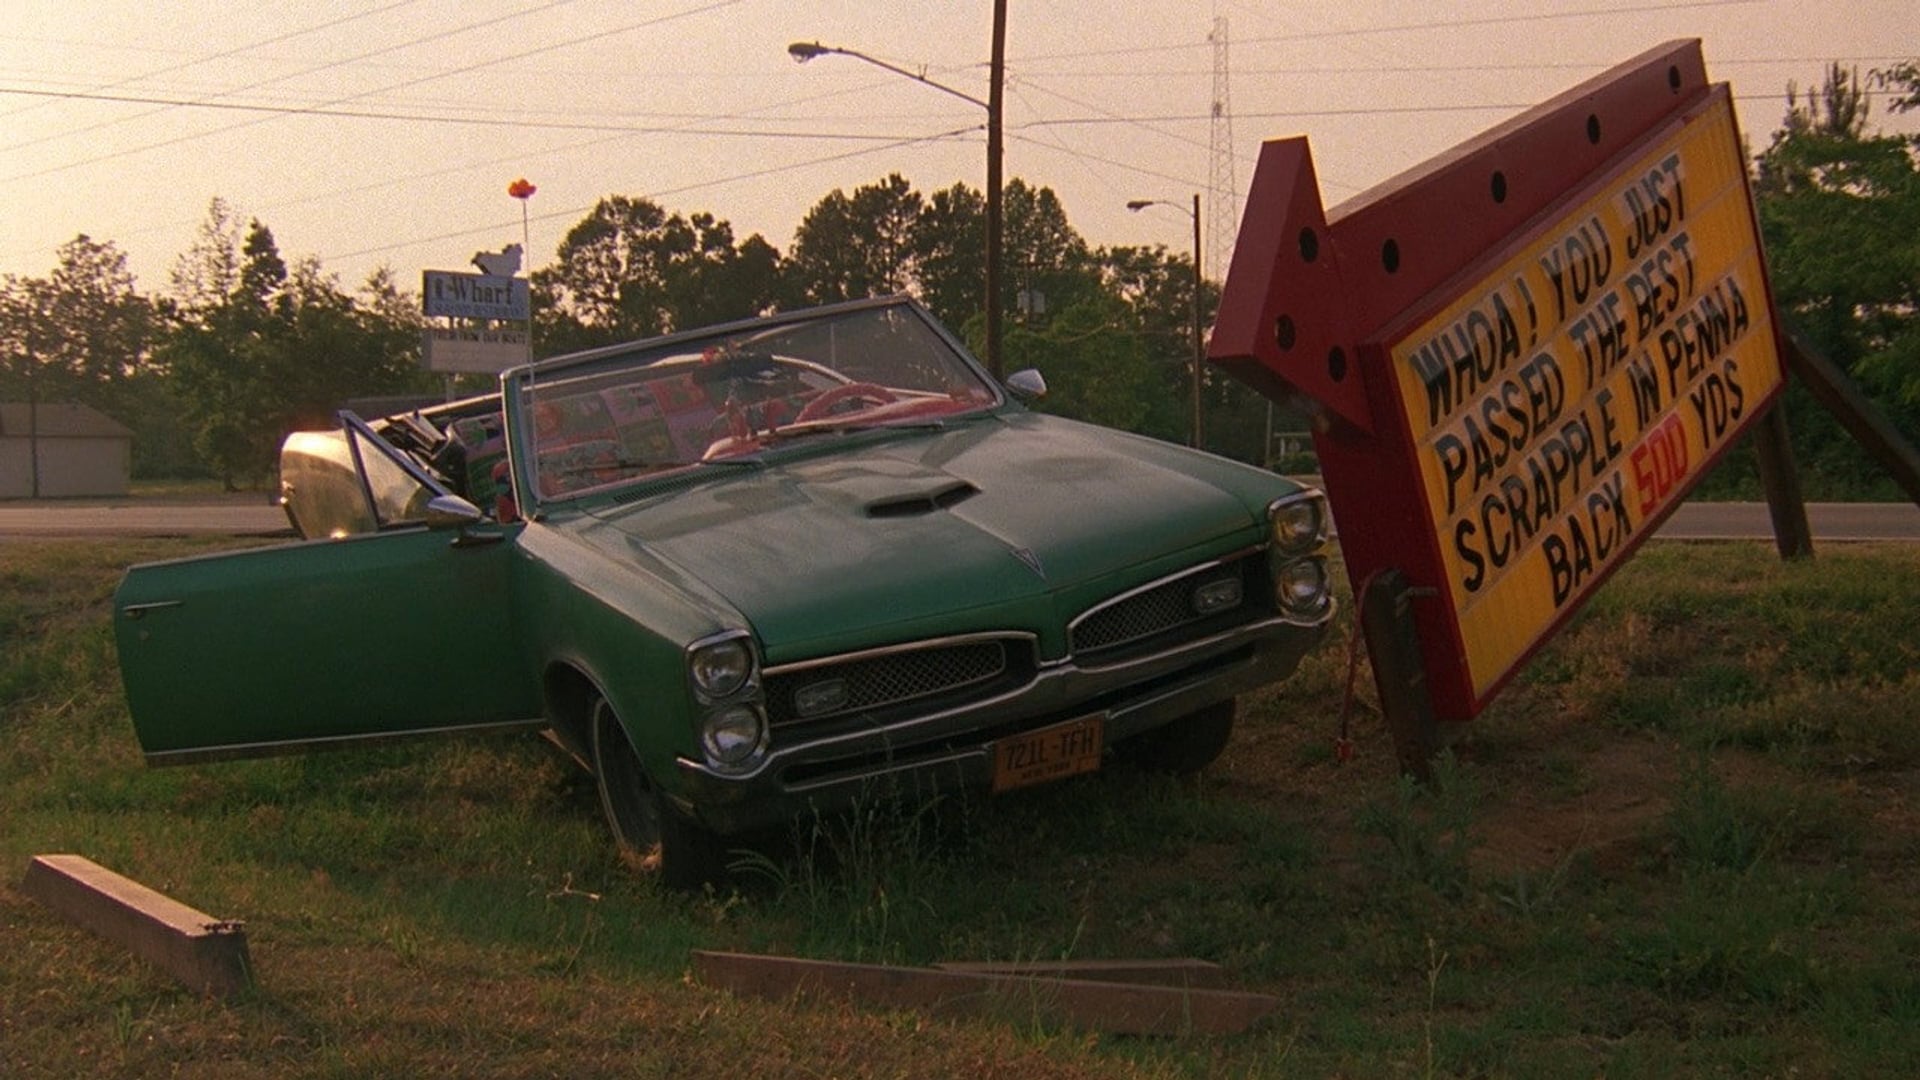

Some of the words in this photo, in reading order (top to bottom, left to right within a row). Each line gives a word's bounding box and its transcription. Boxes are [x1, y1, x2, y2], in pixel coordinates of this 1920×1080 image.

[1540, 216, 1611, 322] YOU
[1623, 153, 1685, 260] JUST
[1434, 352, 1565, 515] PASSED
[1568, 291, 1630, 391] THE
[1626, 231, 1695, 342] BEST
[1455, 387, 1623, 592] SCRAPPLE
[1627, 352, 1662, 433] IN
[1659, 275, 1749, 399] PENNA
[1542, 470, 1632, 608] BACK
[1631, 411, 1690, 518] 500
[1690, 359, 1745, 450] YDS
